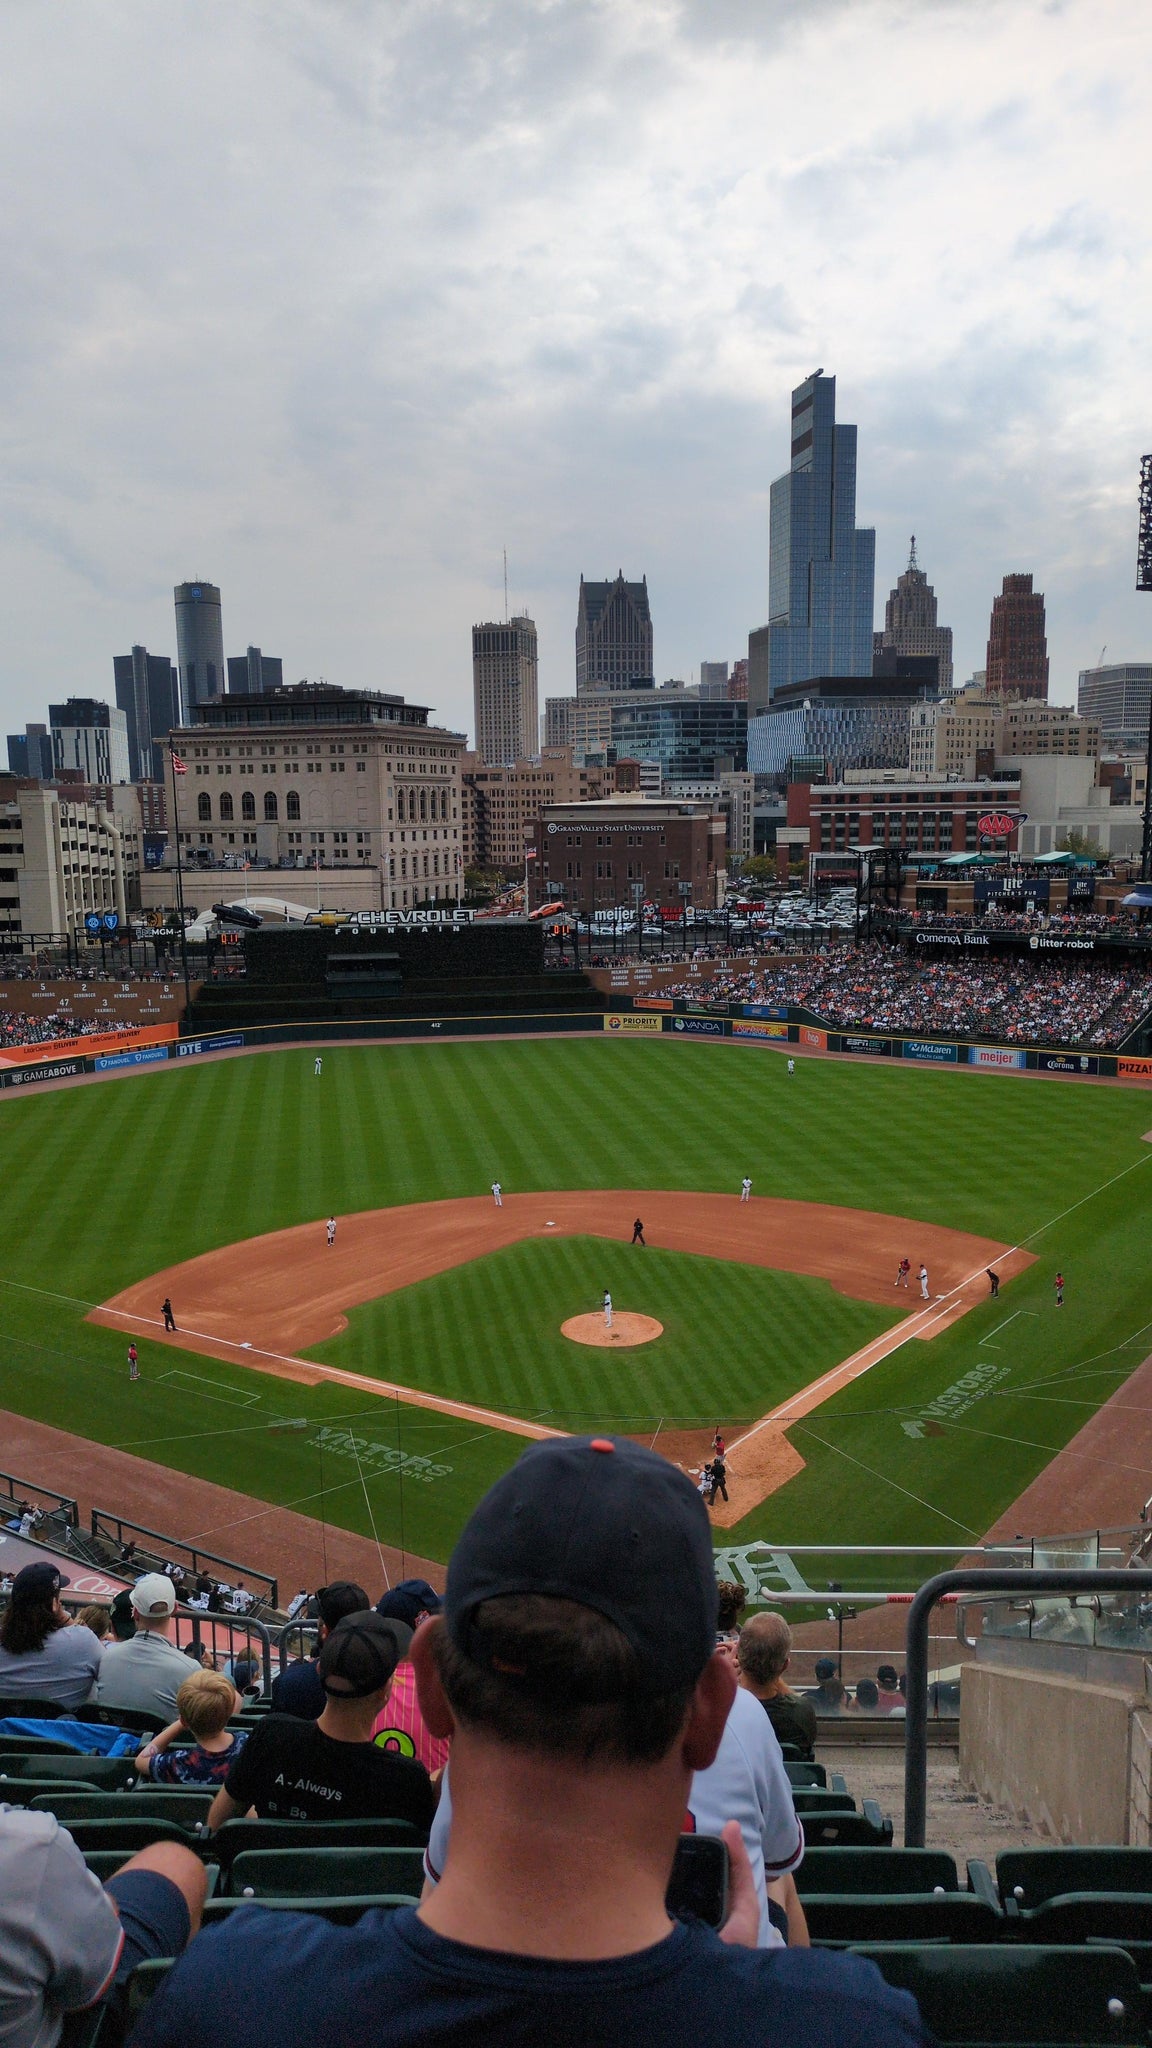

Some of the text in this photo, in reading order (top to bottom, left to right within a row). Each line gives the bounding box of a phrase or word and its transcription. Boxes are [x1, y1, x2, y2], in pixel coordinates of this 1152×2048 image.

[980, 815, 1012, 834] AAA
[1003, 878, 1023, 891] Lite
[357, 910, 477, 924] CHEVROLET
[595, 907, 636, 922] meijer
[335, 926, 460, 935] FOUNTAIN
[964, 935, 990, 945] Bank
[685, 1021, 720, 1031] VANDA
[117, 1030, 141, 1040] DELIVERY
[54, 1040, 78, 1049] DELIVERY
[179, 1043, 202, 1056] DTE
[920, 1044, 951, 1054] McLaren
[107, 1057, 130, 1066] FANDUEL
[142, 1052, 164, 1060] FANDUEL
[980, 1051, 1014, 1064] meijer
[1047, 1060, 1075, 1070] Corona
[24, 1065, 77, 1082] GAMEABOVE
[918, 1364, 998, 1416] VICTORS
[949, 1367, 1012, 1419] HOME SOLUTIONS
[316, 1427, 454, 1477] VICTORS
[304, 1439, 434, 1482] HOME SOLUTIONS
[275, 1774, 284, 1786] A
[294, 1778, 342, 1800] Always
[268, 1801, 277, 1811] B
[290, 1806, 307, 1819] Be
